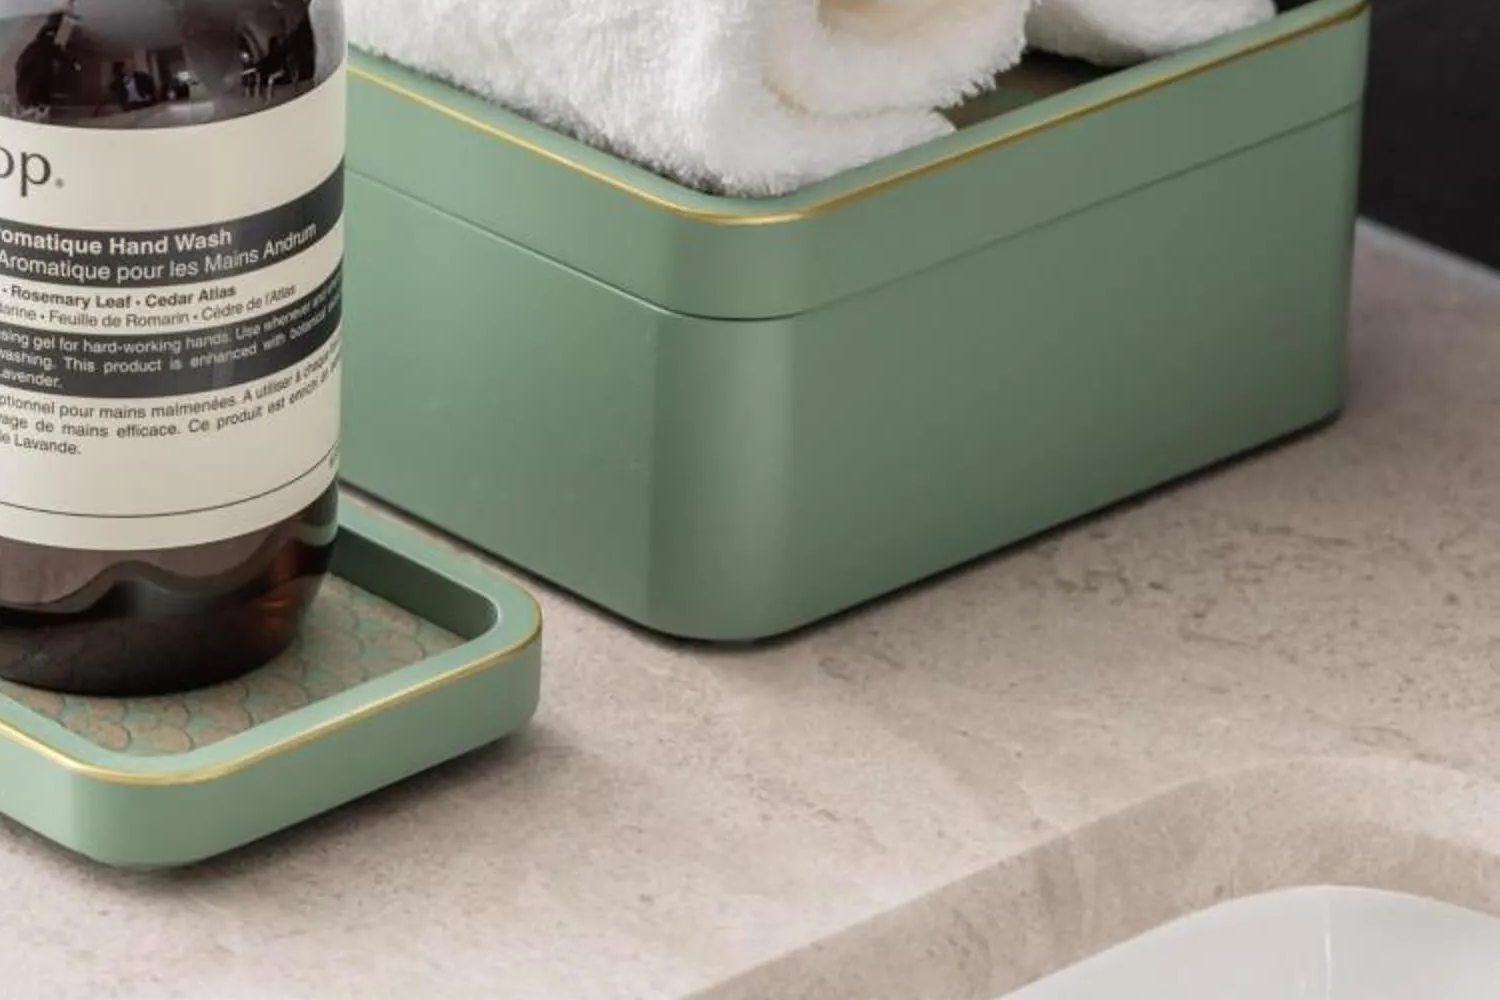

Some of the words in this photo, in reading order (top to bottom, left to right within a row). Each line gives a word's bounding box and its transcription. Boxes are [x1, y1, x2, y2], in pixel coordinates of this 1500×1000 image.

[108, 235, 169, 256] Hand
[173, 228, 233, 253] Wash
[116, 264, 166, 285] pour
[168, 259, 200, 278] les
[203, 247, 260, 274] Mains
[262, 222, 318, 260] Andrum
[10, 284, 92, 311] Rosemary
[95, 294, 132, 309] Leaf
[144, 292, 194, 309] Cedar
[197, 284, 238, 302] Atlas
[48, 308, 99, 328] Feuille
[100, 313, 122, 328] de
[124, 311, 191, 329] Romarin
[245, 295, 263, 312] de
[33, 335, 56, 352] gel
[58, 337, 80, 353] for
[82, 337, 182, 355] hard-working
[62, 355, 96, 374] This
[102, 358, 163, 376] product
[168, 354, 183, 371] is
[34, 416, 56, 435] de
[60, 422, 109, 438] mains
[186, 416, 211, 434] Ce
[216, 406, 264, 432] produit
[59, 403, 96, 419] pour
[98, 404, 147, 419] mains
[13, 433, 83, 456] Lavande.
